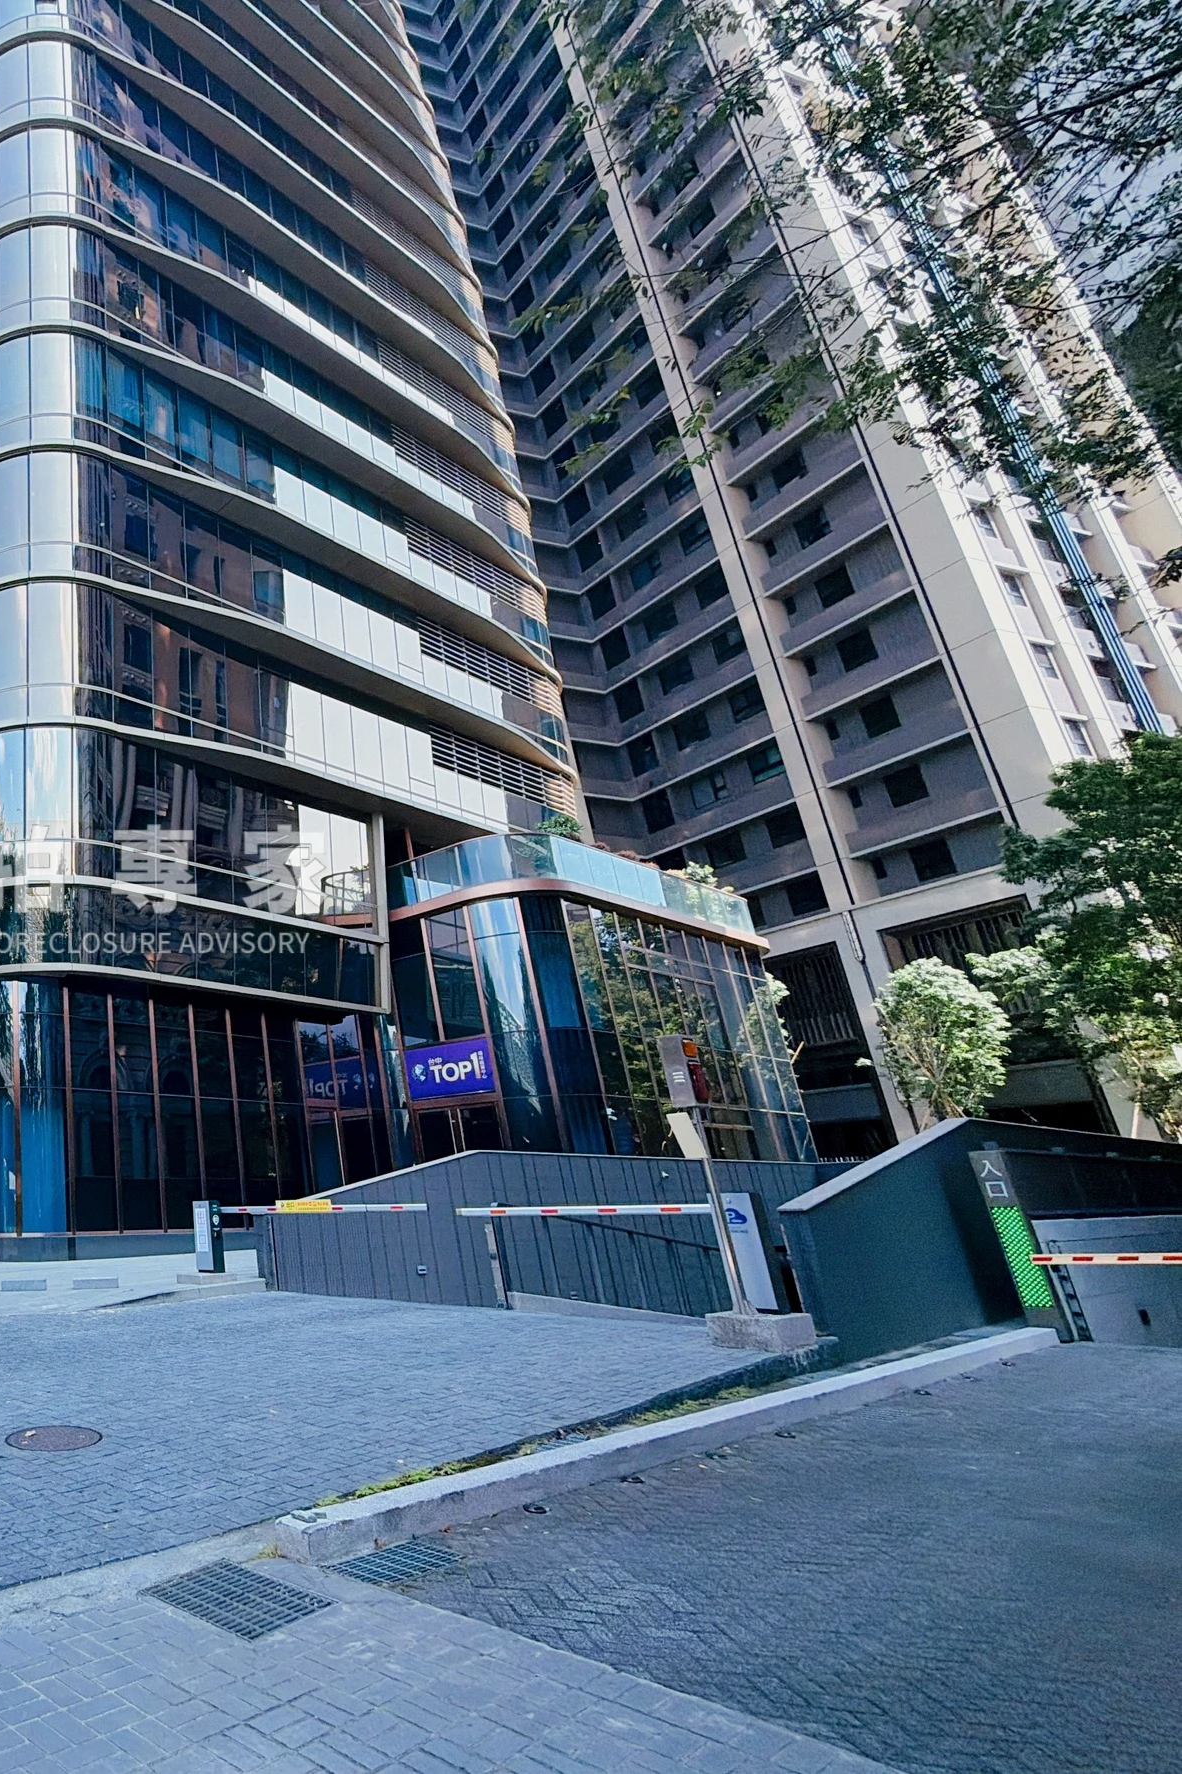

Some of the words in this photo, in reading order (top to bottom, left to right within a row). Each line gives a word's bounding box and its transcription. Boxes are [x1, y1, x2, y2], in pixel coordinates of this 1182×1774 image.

[427, 1056, 443, 1066] 台中
[429, 1051, 482, 1084] TOP1
[980, 1160, 1009, 1198] 入口
